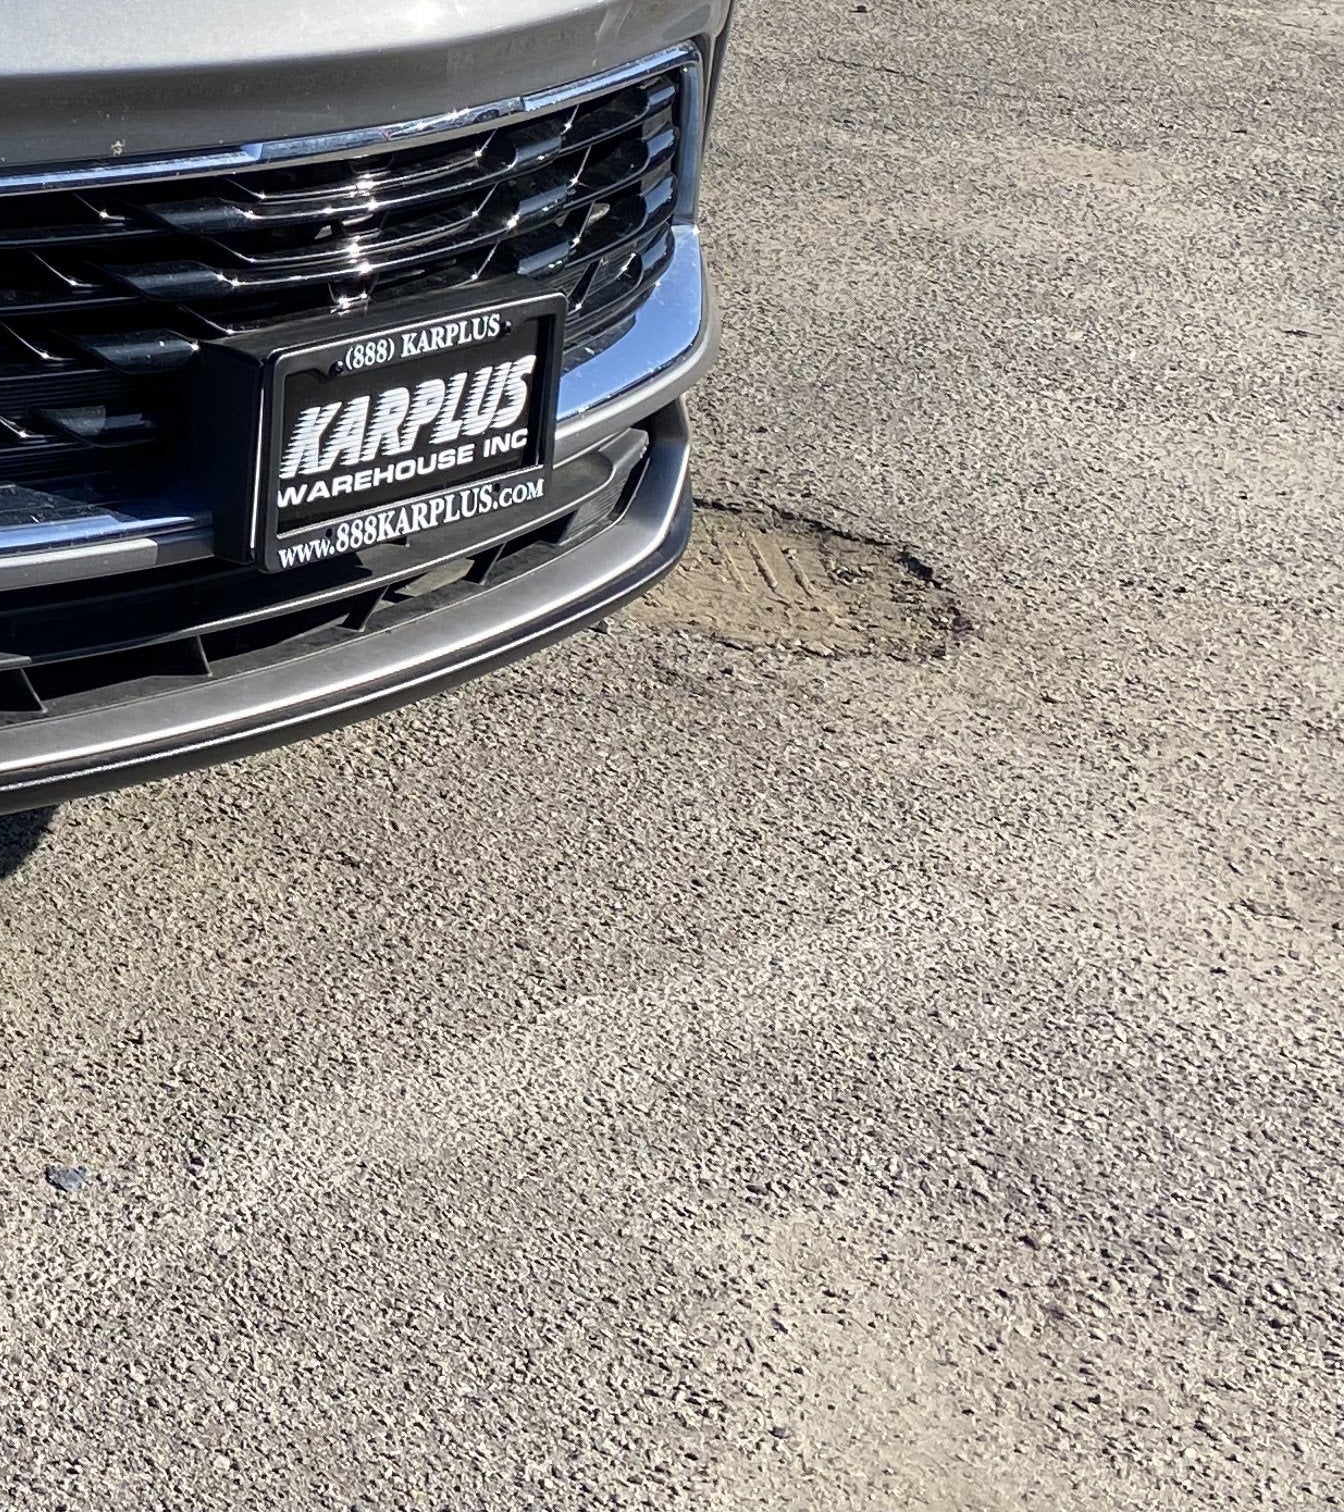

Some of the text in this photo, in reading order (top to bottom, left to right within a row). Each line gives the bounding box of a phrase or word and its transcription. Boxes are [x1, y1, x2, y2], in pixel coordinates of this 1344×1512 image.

[345, 313, 501, 371] (888) KARPLUS
[278, 354, 537, 479] KARPLUS
[277, 428, 529, 509] WAREHOUSE INC
